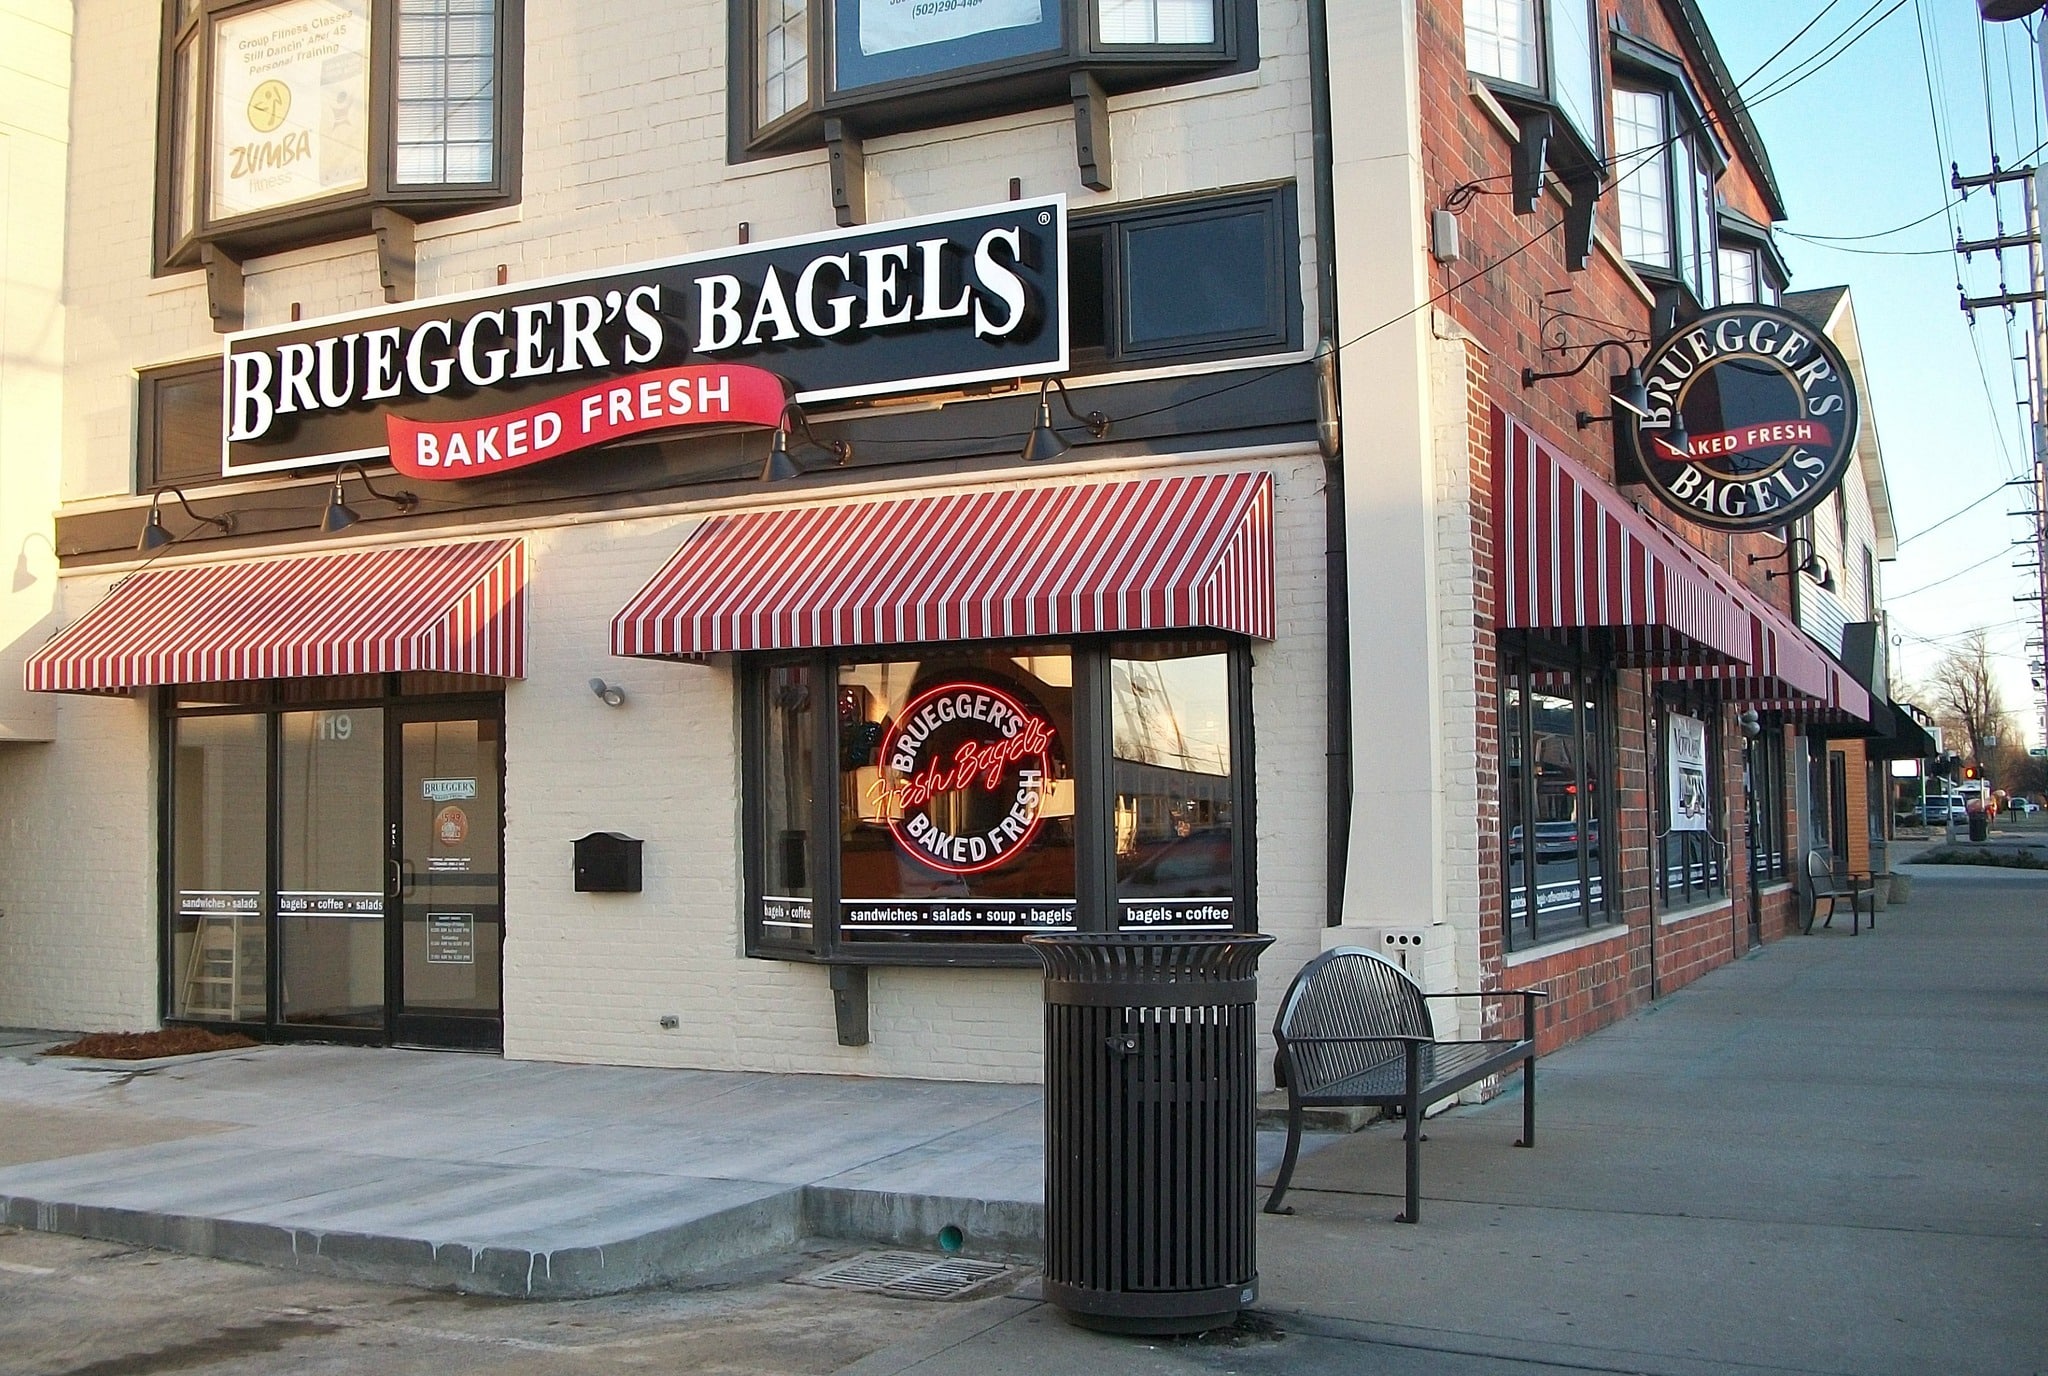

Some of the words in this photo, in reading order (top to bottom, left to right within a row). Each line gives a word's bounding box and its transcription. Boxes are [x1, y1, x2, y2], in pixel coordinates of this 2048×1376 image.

[239, 35, 269, 51] Group
[272, 23, 309, 41] Fitness
[312, 10, 353, 29] Classes
[244, 50, 264, 63] Still
[267, 38, 304, 57] Dancin'
[308, 32, 329, 45] After
[333, 24, 347, 36] 45
[249, 56, 293, 76] Personal
[297, 43, 340, 61] Training
[229, 130, 312, 179] ZUMBA
[249, 174, 293, 193] fitness
[227, 283, 665, 442] BRUEGGER'S
[692, 225, 1026, 353] BAGELS
[1639, 318, 1844, 431] BRUEGGER'S
[416, 411, 563, 468] BAKED
[580, 375, 731, 434] FRESH
[1671, 435, 1738, 457] AKED
[1747, 424, 1812, 446] FRESH
[1667, 448, 1826, 516] BAGELS
[317, 714, 352, 740] 119
[891, 693, 1023, 773] BRUEGGER'S
[955, 717, 1056, 790] Bagels
[424, 781, 475, 794] BRUEGGER'S
[906, 812, 987, 863] BAKED
[988, 769, 1042, 855] FRESH
[182, 897, 226, 909] sandwiches
[232, 897, 258, 909] salads
[280, 898, 308, 912] bagels
[317, 898, 344, 910] coffee
[356, 898, 384, 911] salads
[764, 903, 785, 920] bagels
[791, 905, 812, 920] coffee
[850, 907, 918, 922] sandwiches
[932, 907, 972, 922] salads
[986, 910, 1016, 925] soup
[1030, 907, 1073, 924] bagels
[1127, 906, 1173, 924] bagels
[1185, 905, 1230, 921] coffee
